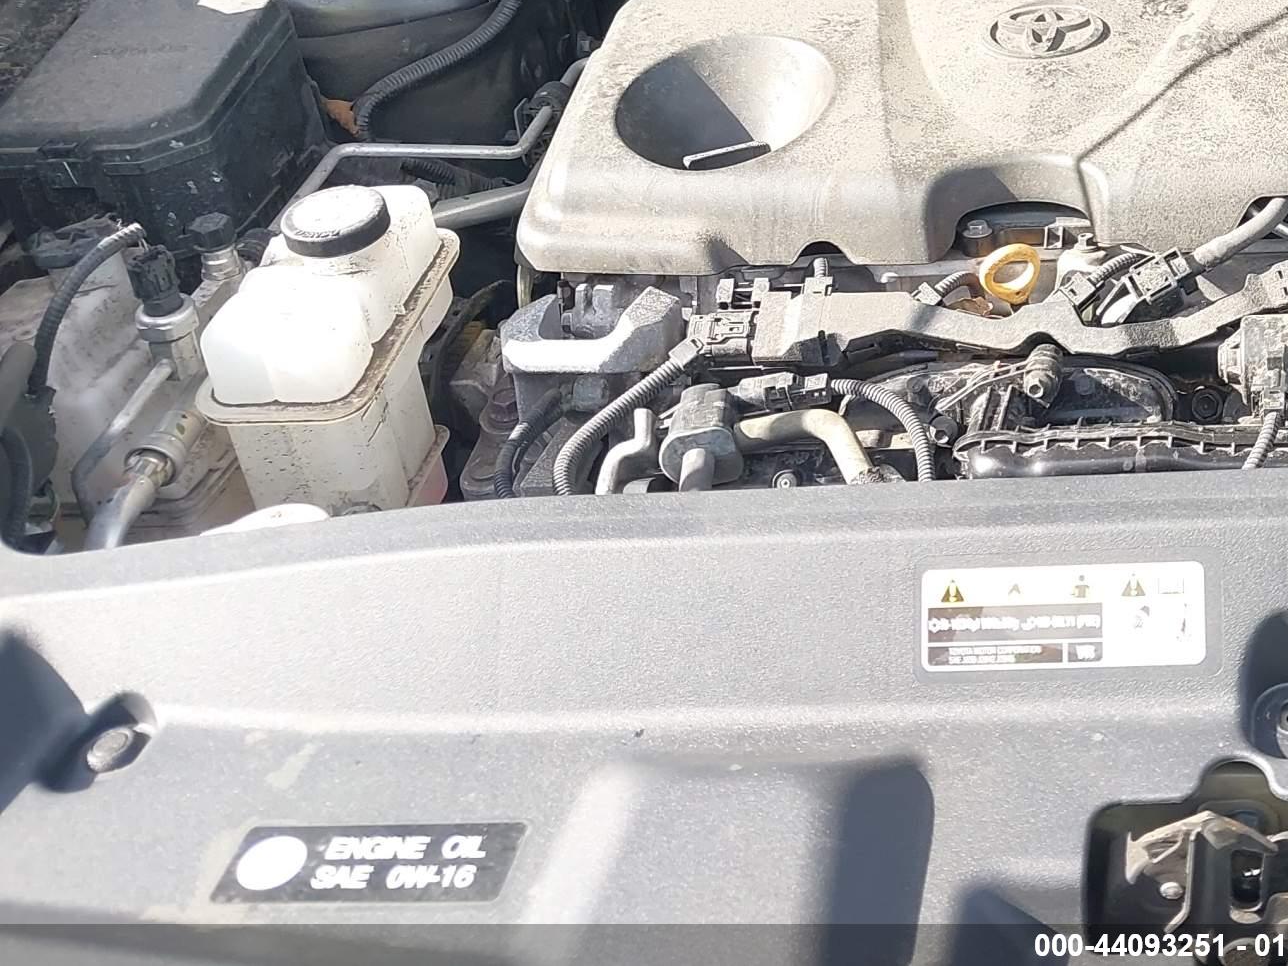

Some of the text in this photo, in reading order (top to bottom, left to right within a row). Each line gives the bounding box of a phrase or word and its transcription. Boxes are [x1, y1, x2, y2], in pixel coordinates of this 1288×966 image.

[324, 835, 486, 860] ENGINE OIL
[310, 864, 477, 890] SAE 0W-16
